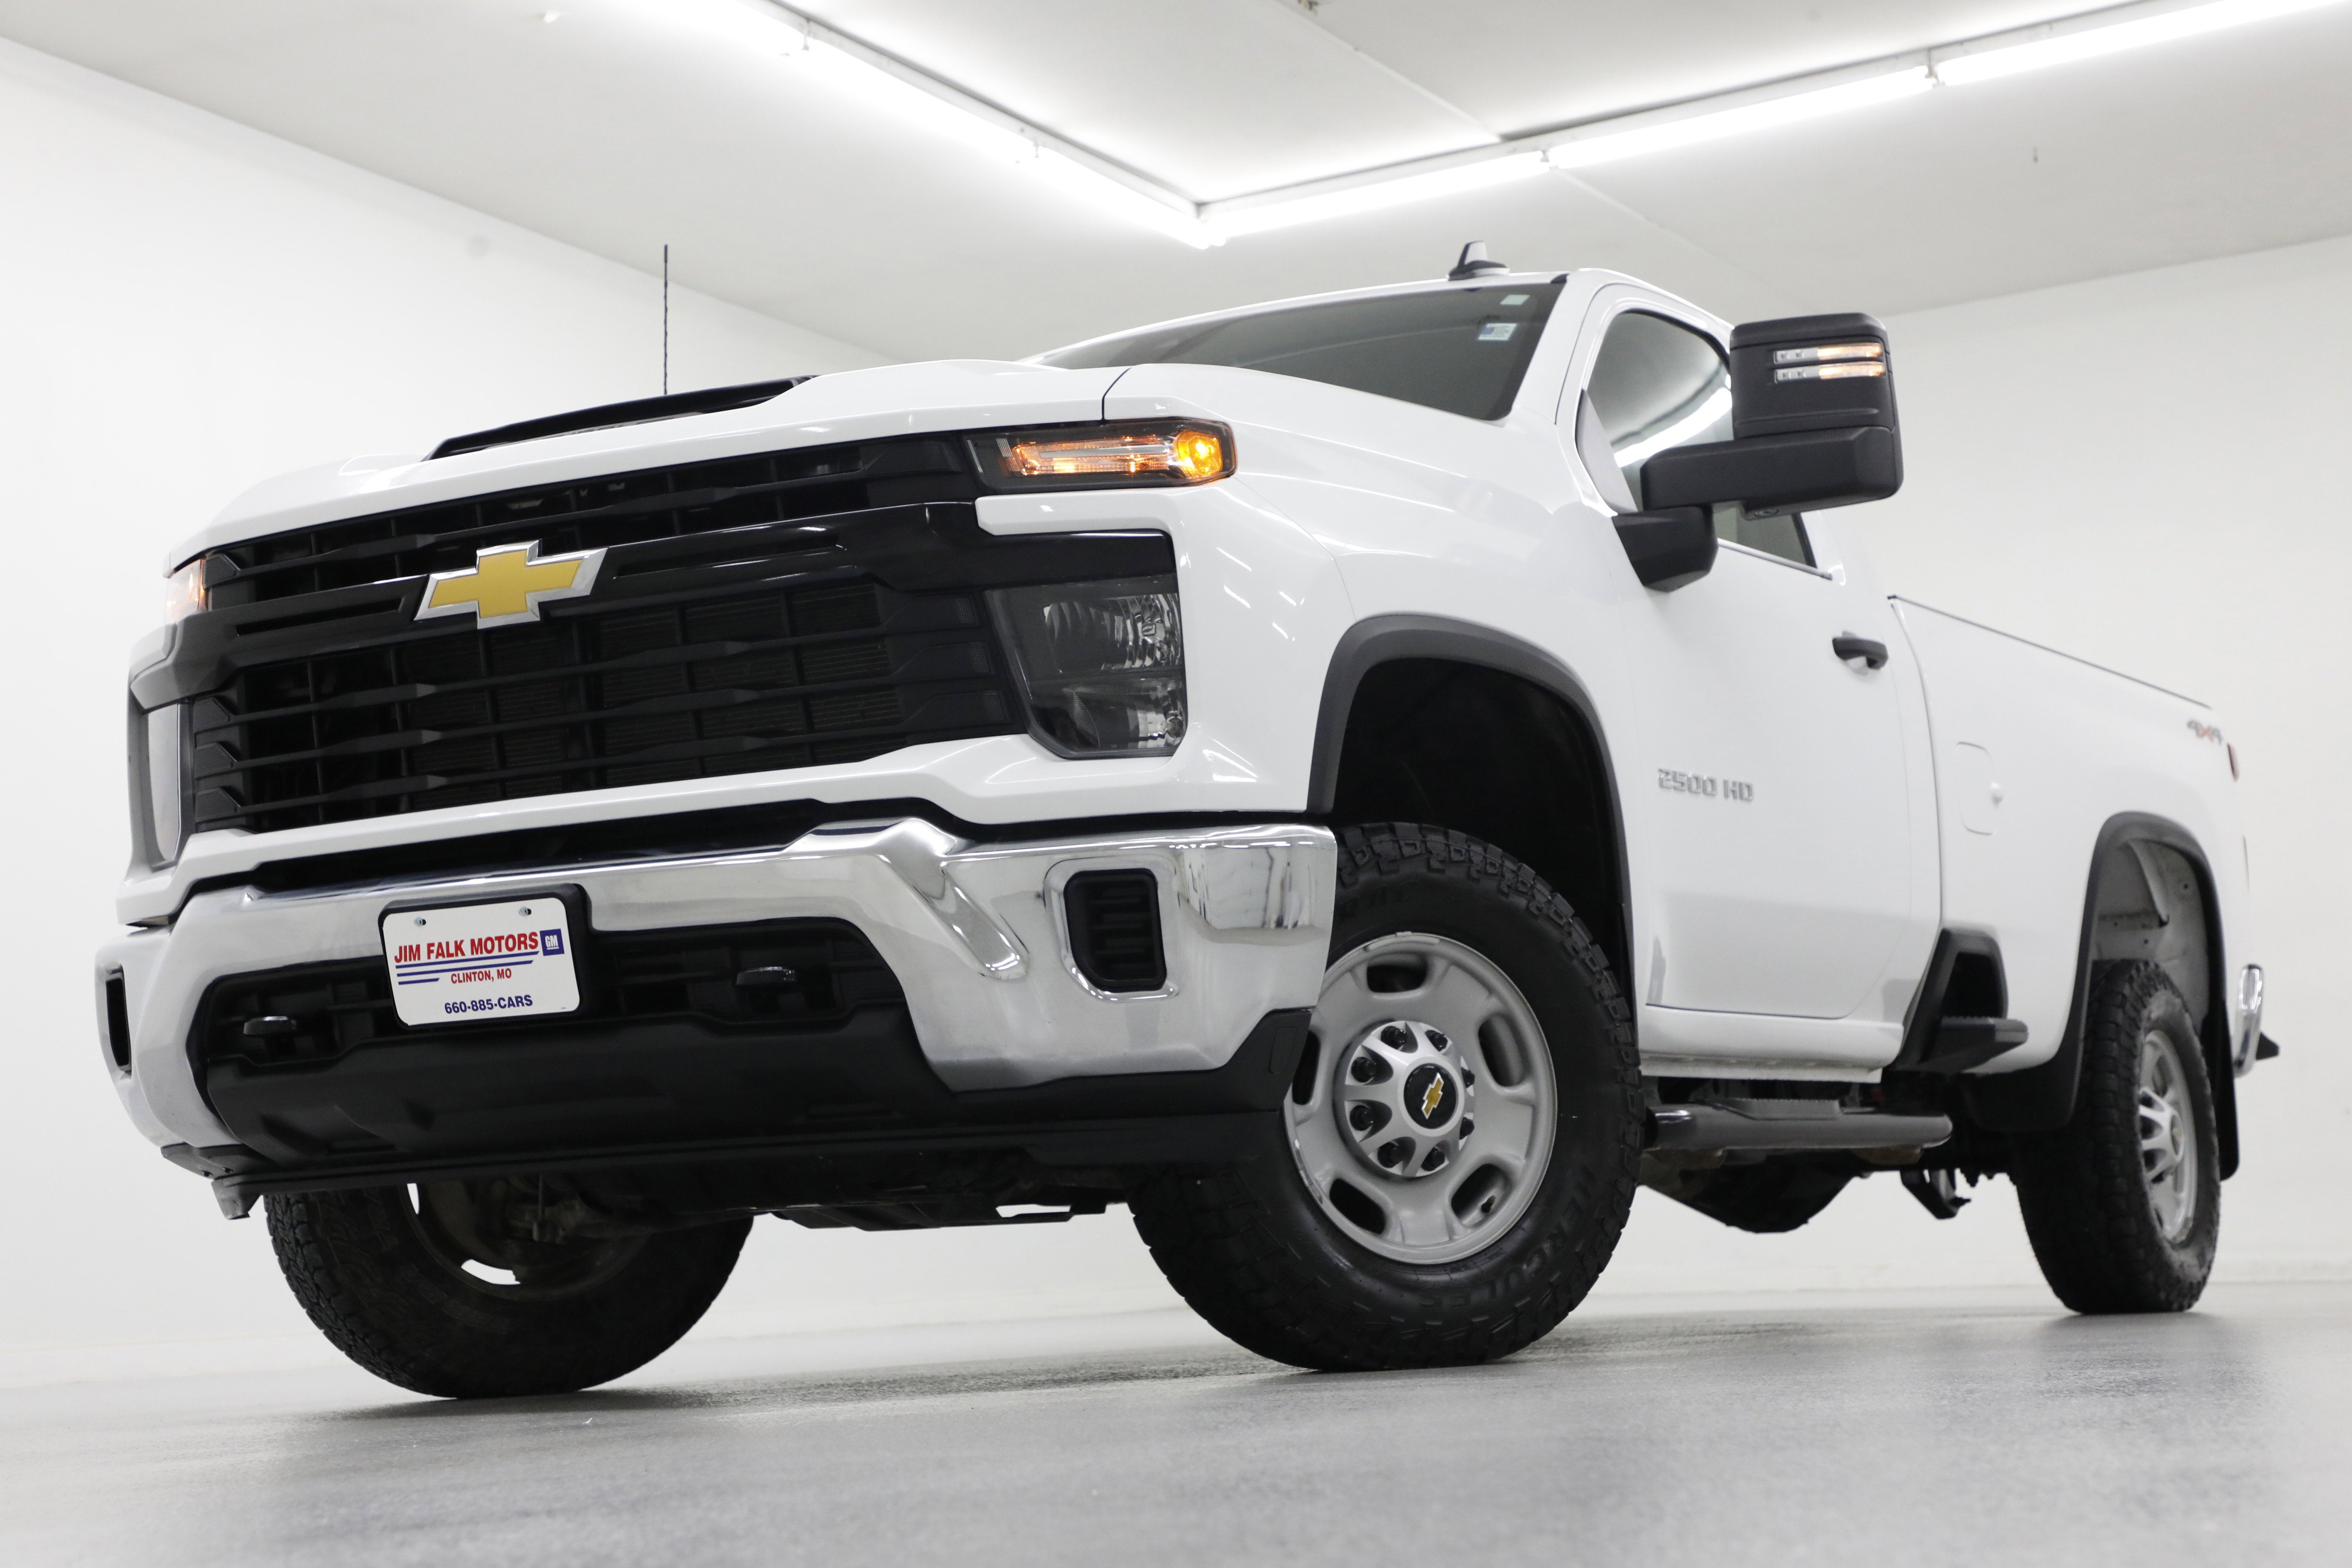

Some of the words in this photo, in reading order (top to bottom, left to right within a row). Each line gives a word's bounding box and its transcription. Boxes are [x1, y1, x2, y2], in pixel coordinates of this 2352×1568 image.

[1658, 768, 1717, 797] 2500
[1724, 779, 1754, 802] HD
[394, 944, 421, 963] JIM
[427, 940, 466, 960] FALK
[470, 931, 539, 956] MOTORS
[545, 935, 559, 949] GM
[451, 969, 494, 984] CLINTON,
[497, 968, 512, 979] MO
[444, 995, 533, 1014] 660-885-CARS
